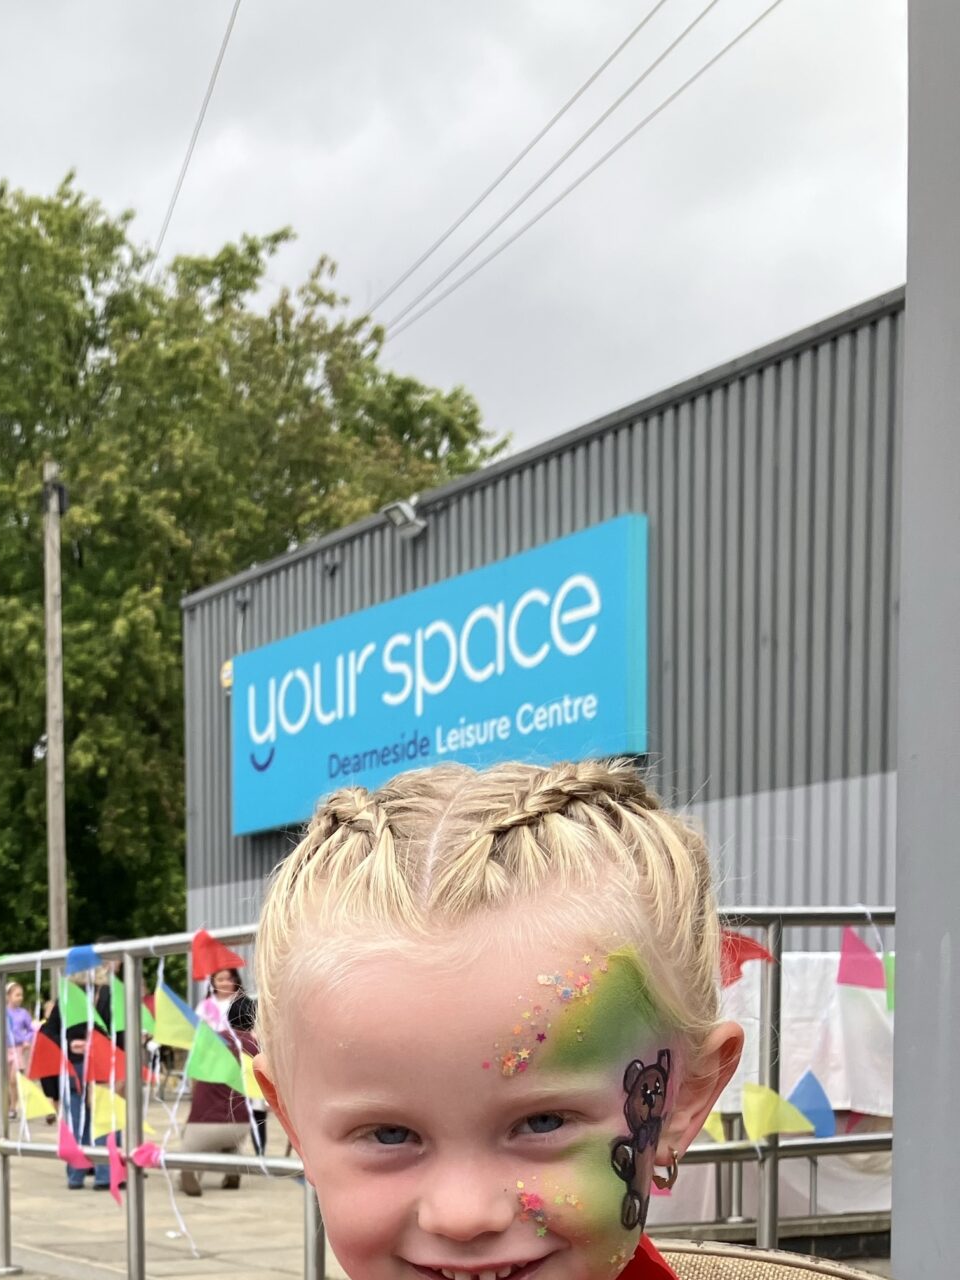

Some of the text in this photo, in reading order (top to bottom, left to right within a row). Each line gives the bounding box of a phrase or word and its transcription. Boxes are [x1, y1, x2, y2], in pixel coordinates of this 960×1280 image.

[328, 692, 599, 780] Dearneside Leisure Centre
